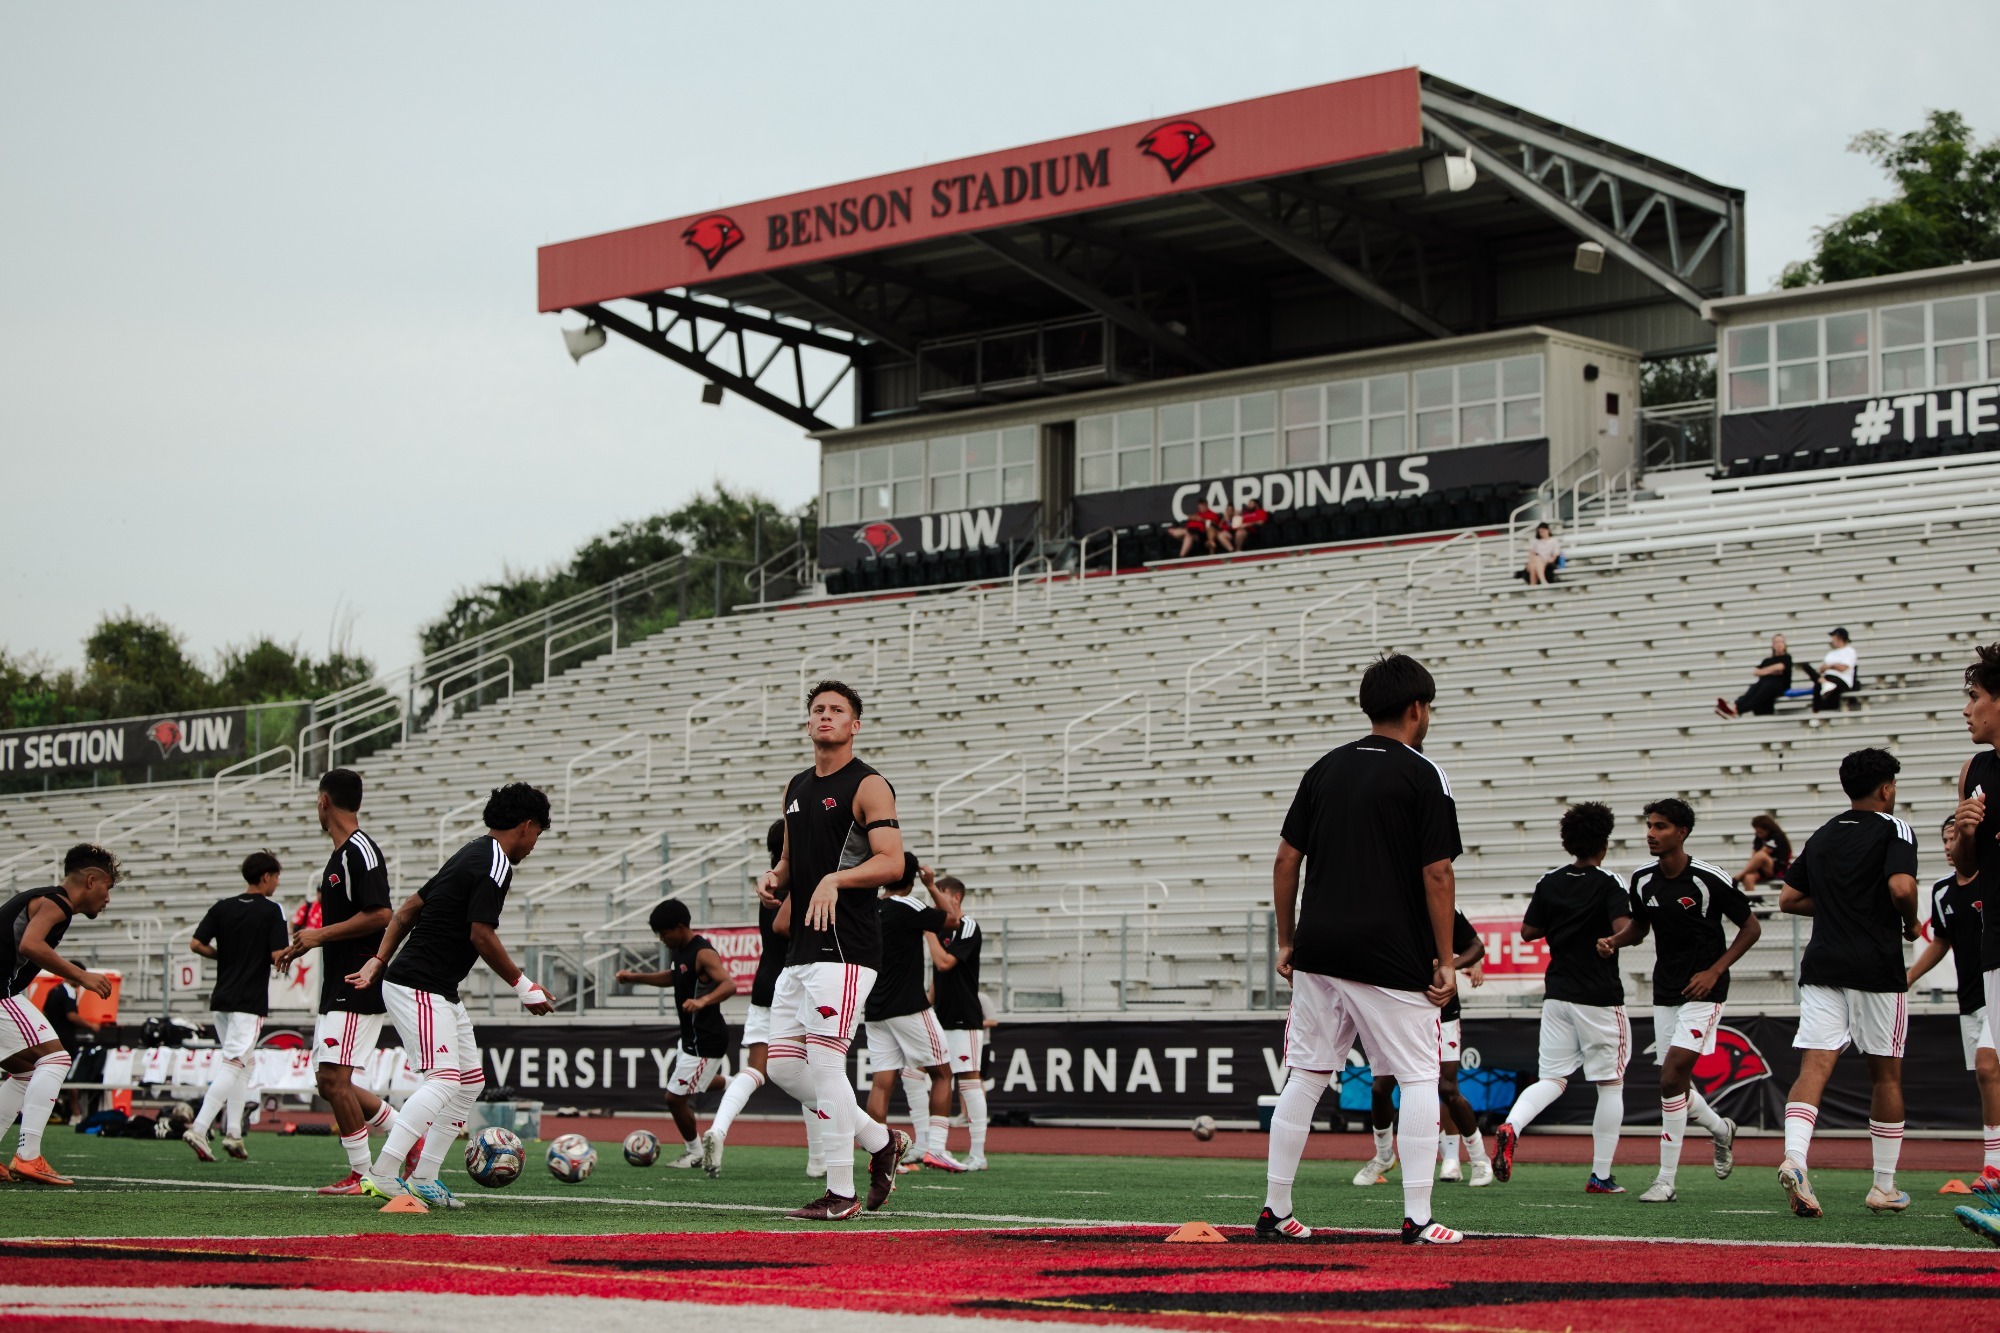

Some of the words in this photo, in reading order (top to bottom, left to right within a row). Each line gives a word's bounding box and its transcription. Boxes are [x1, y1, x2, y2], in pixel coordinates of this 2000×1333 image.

[766, 186, 915, 253] BENSON
[930, 146, 1111, 219] STADIUM
[1851, 385, 2000, 446] #THE
[1171, 455, 1430, 523] CARDINALS
[919, 507, 1003, 554] UIW
[24, 727, 124, 769] SECTION
[178, 715, 233, 754] UIW
[181, 966, 194, 986] D
[477, 1047, 678, 1089] VERSITY
